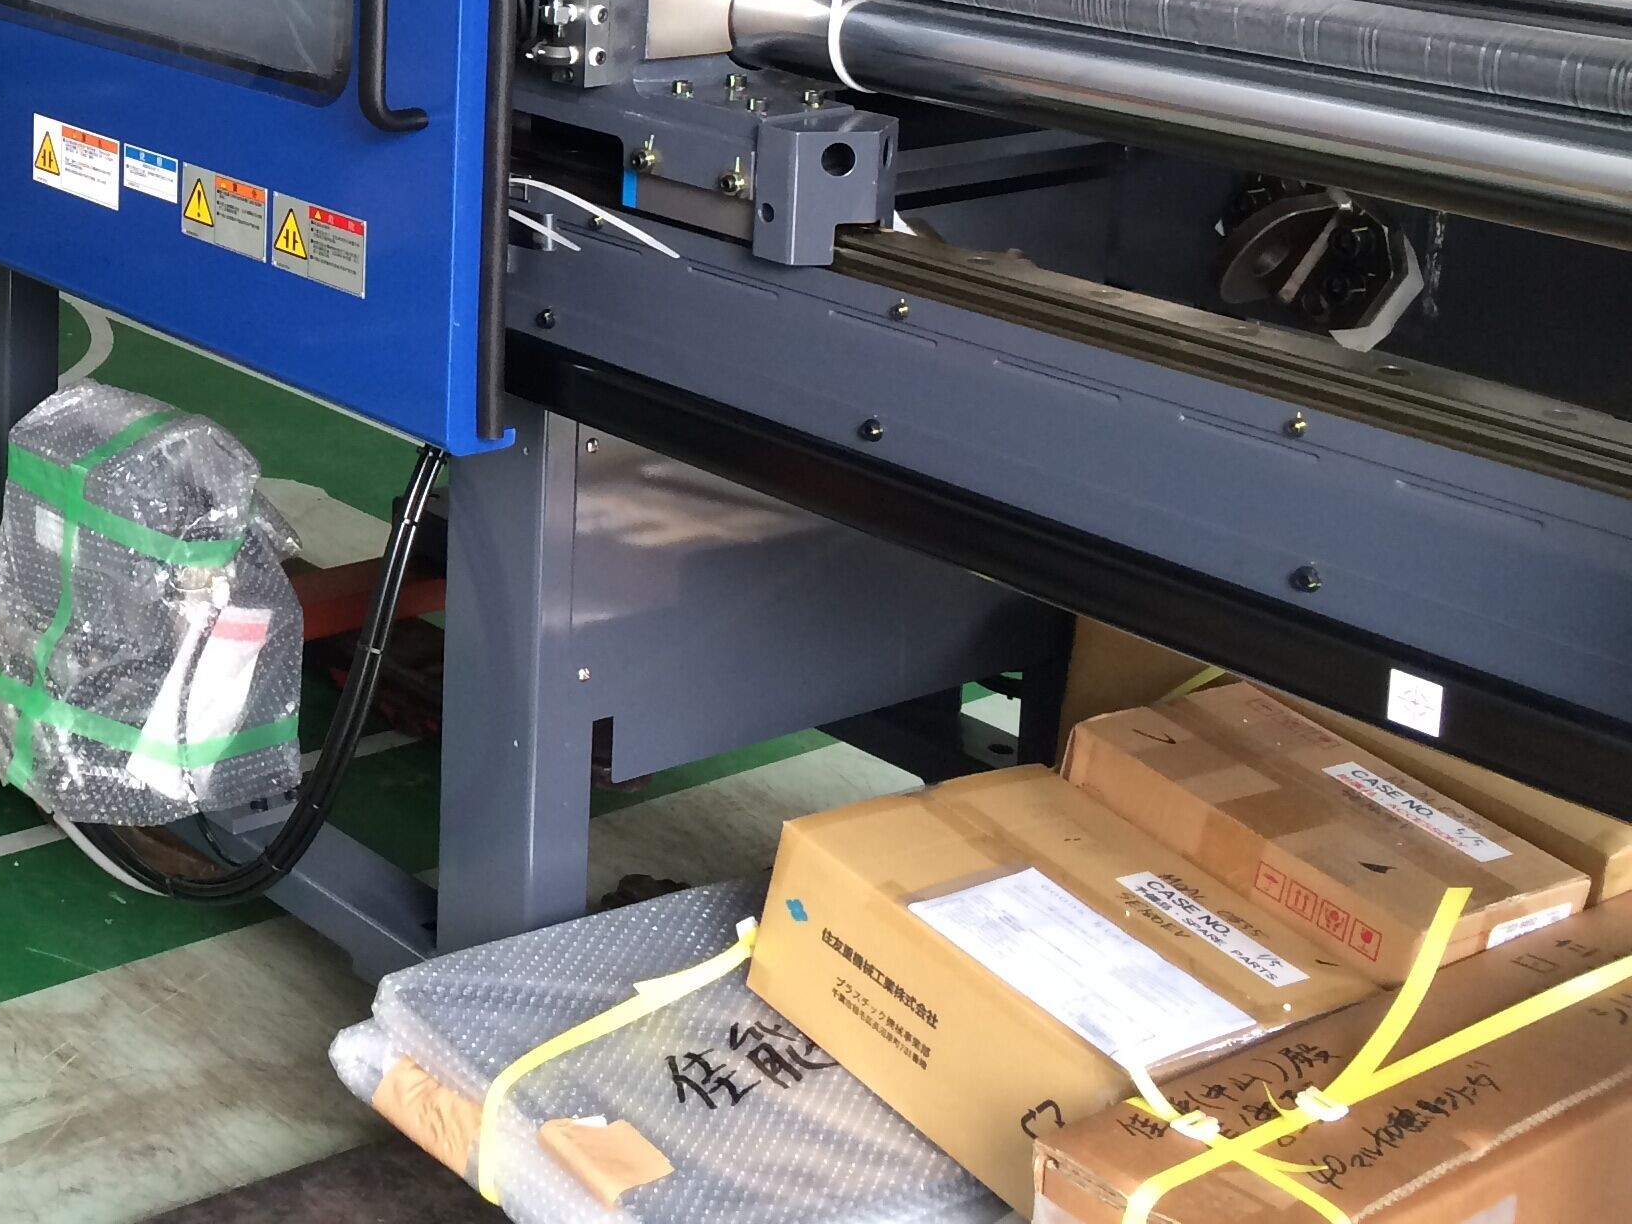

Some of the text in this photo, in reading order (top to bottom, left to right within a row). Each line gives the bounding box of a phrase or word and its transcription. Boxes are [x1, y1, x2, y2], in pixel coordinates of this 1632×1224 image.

[1351, 769, 1404, 799] CASE
[1401, 799, 1435, 819] NO.
[1386, 803, 1467, 848] ACCESSORY
[1147, 880, 1201, 914] CASE
[1198, 914, 1231, 937] NO.
[1182, 917, 1227, 946] SPARE
[1230, 949, 1278, 980] PARTS
[821, 927, 939, 1030] 住友重機械工業株式会社
